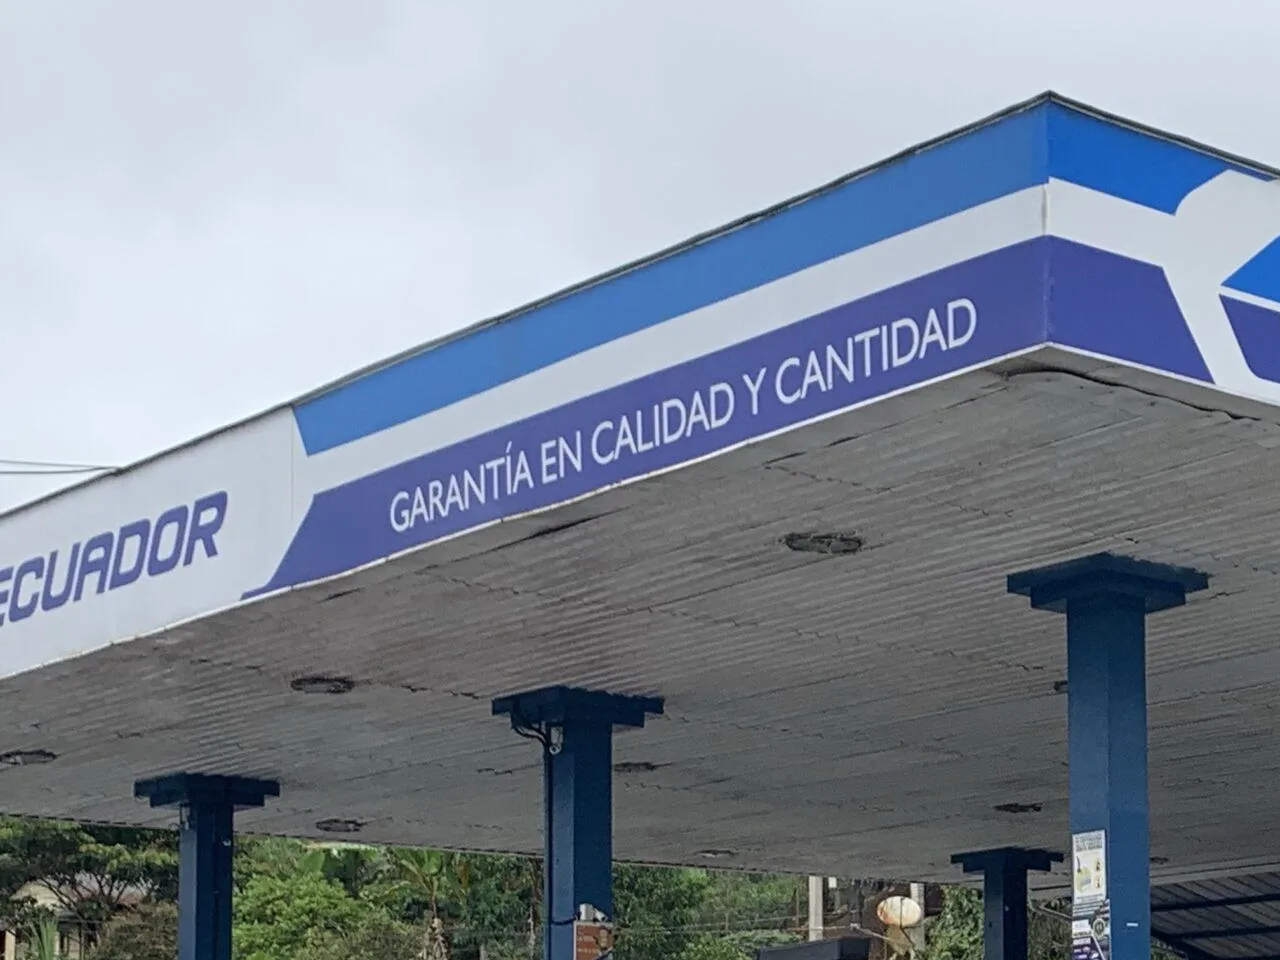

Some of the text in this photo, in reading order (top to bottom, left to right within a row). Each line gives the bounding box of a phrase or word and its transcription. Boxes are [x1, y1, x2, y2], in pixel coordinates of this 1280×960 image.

[389, 297, 977, 533] GARANTÍA EN CALIDAD Y CANTIDAD
